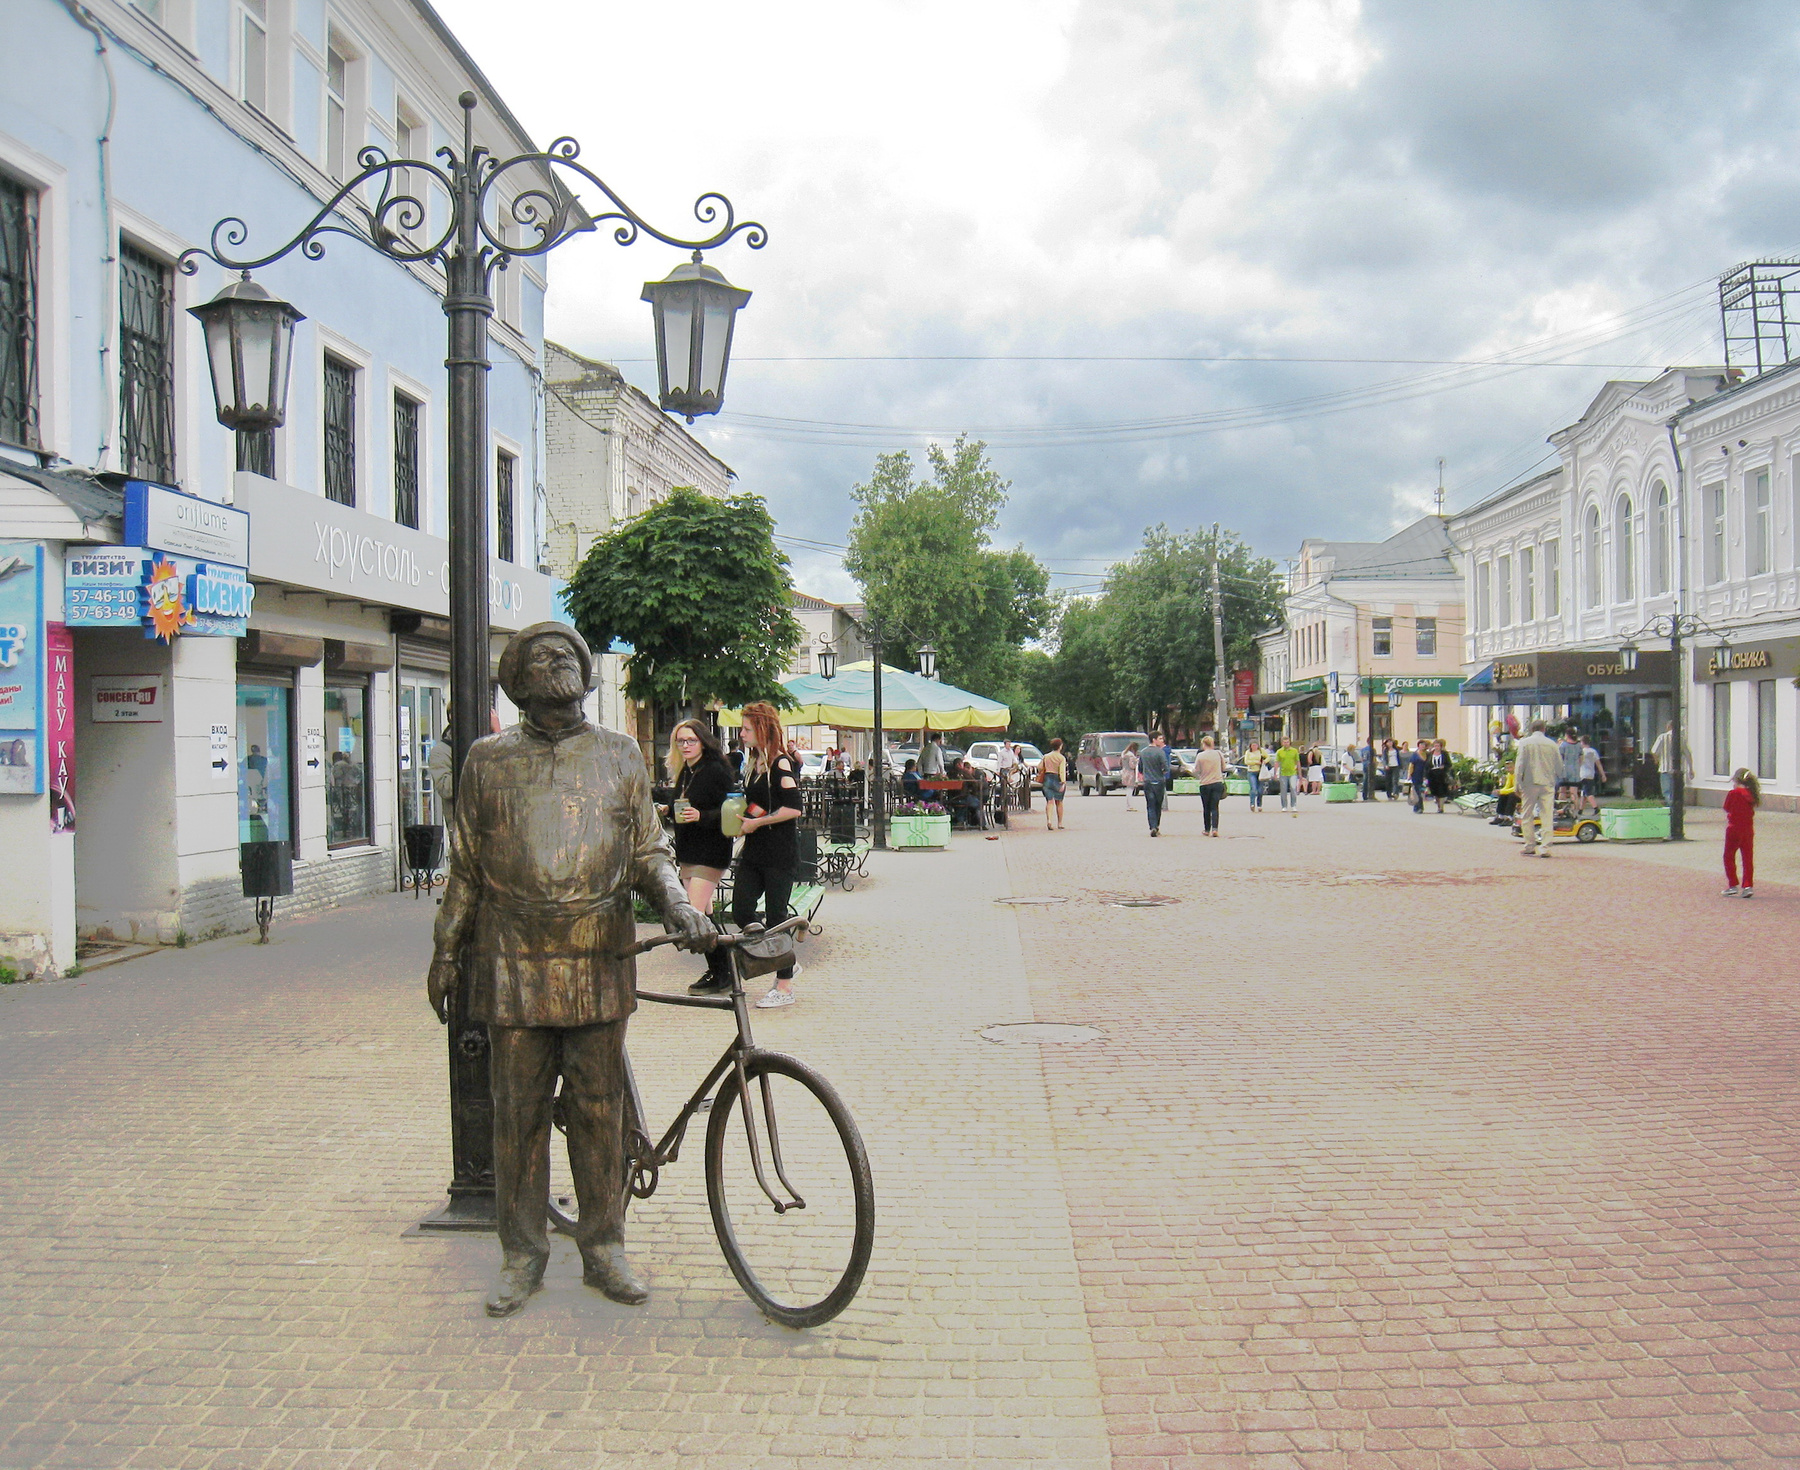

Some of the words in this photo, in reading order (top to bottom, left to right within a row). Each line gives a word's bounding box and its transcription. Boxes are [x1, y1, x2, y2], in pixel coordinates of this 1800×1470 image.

[177, 501, 228, 531] oriflame
[314, 521, 420, 587] хрусталь
[71, 561, 136, 575] ВИЗИТ
[71, 589, 136, 603] 57-46-10
[198, 578, 253, 615] ВИЗИТ
[71, 606, 136, 619] 57-63-49
[1396, 679, 1442, 688] СКБ-БАНК
[54, 655, 68, 731] MARY
[97, 691, 152, 703] CONCERT.RU
[114, 709, 120, 717] 2
[211, 725, 228, 735] ВХОД
[57, 741, 69, 799] KAY
